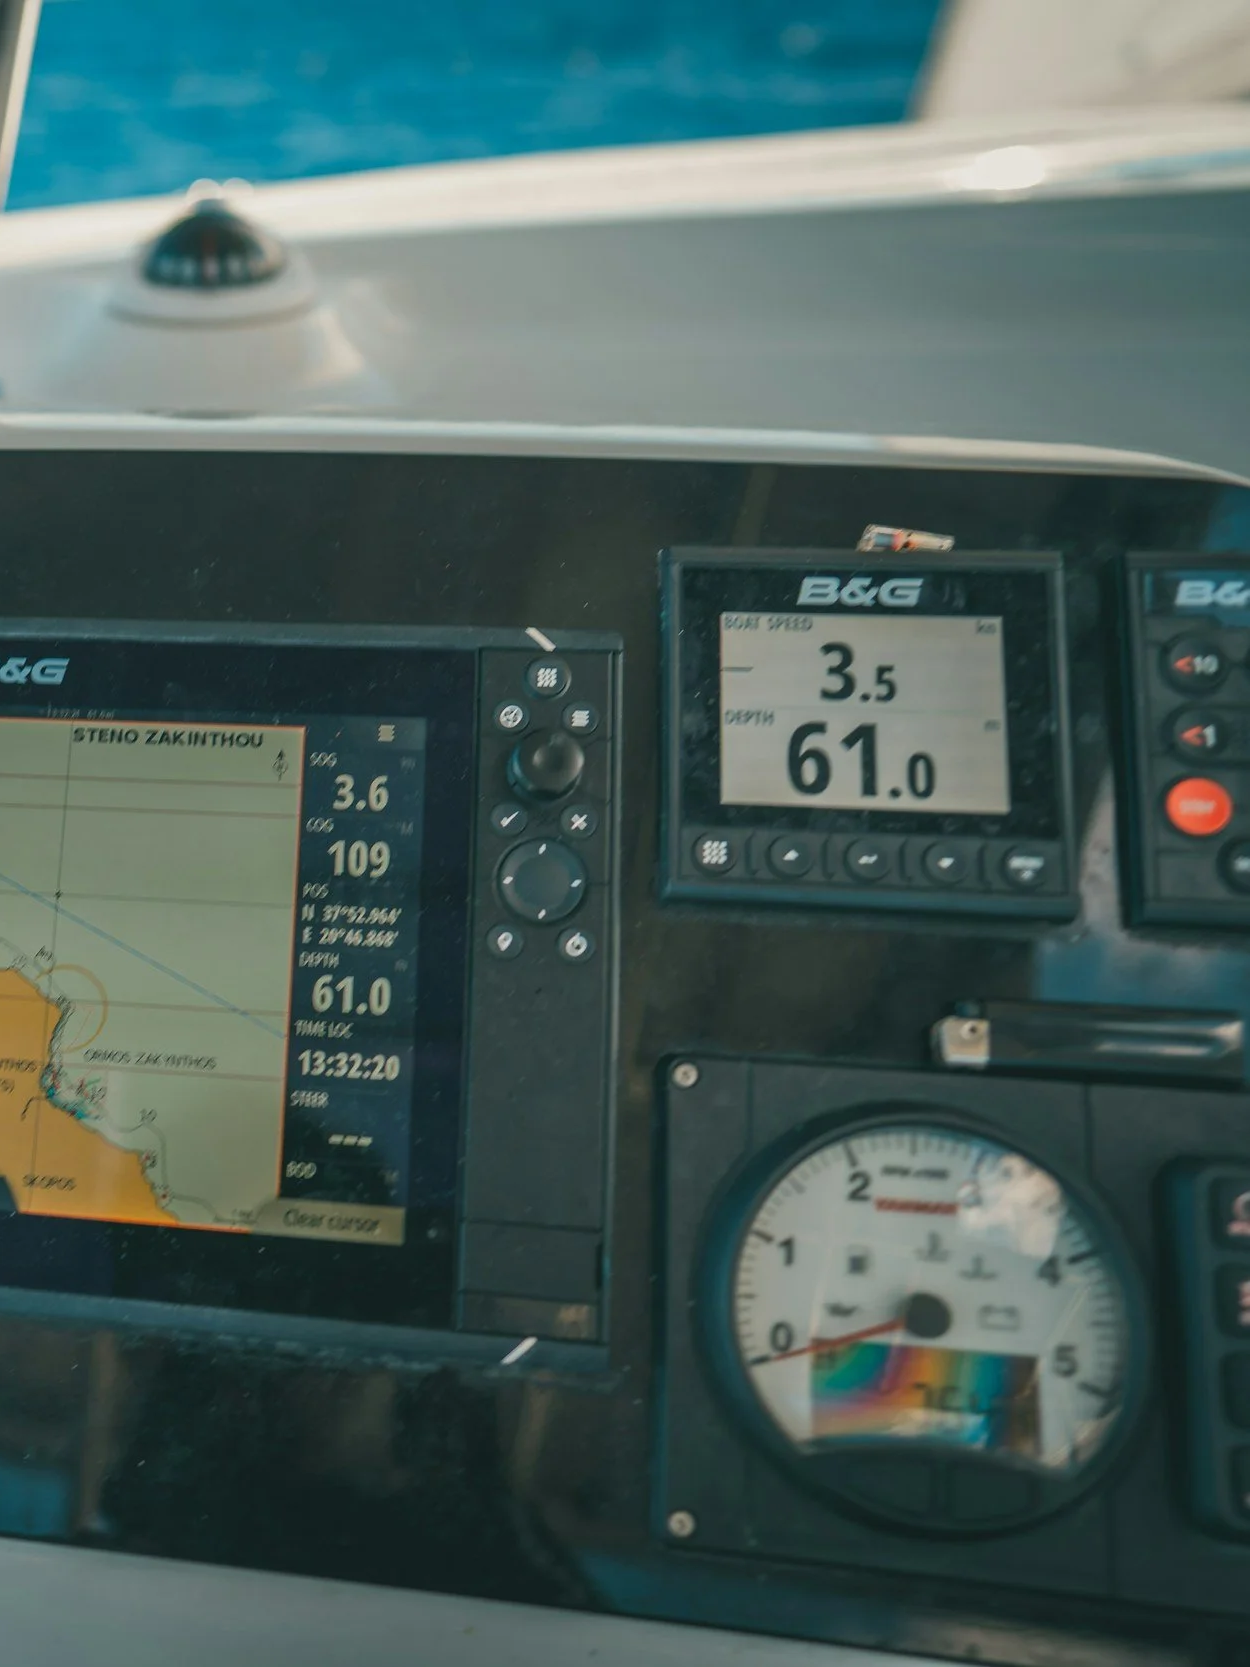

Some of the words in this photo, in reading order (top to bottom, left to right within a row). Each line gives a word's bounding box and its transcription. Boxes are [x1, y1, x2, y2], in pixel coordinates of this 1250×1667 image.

[797, 576, 924, 607] B&G
[723, 616, 761, 632] BOAT
[767, 616, 812, 633] SPEED
[819, 641, 897, 703] 3.5
[724, 710, 774, 727] DEPTH
[73, 727, 139, 746] STENO
[144, 729, 266, 750] ZAKINTHOU
[788, 721, 937, 800] 61.0
[332, 773, 390, 812] 3.6
[327, 839, 391, 879] 109
[311, 973, 392, 1017] 61.0
[297, 1048, 400, 1082] 13:32:20
[847, 1170, 871, 1201] 2
[777, 1236, 796, 1267] 1
[1036, 1254, 1063, 1287] 4
[770, 1320, 794, 1352] 0
[1055, 1345, 1078, 1379] 5
